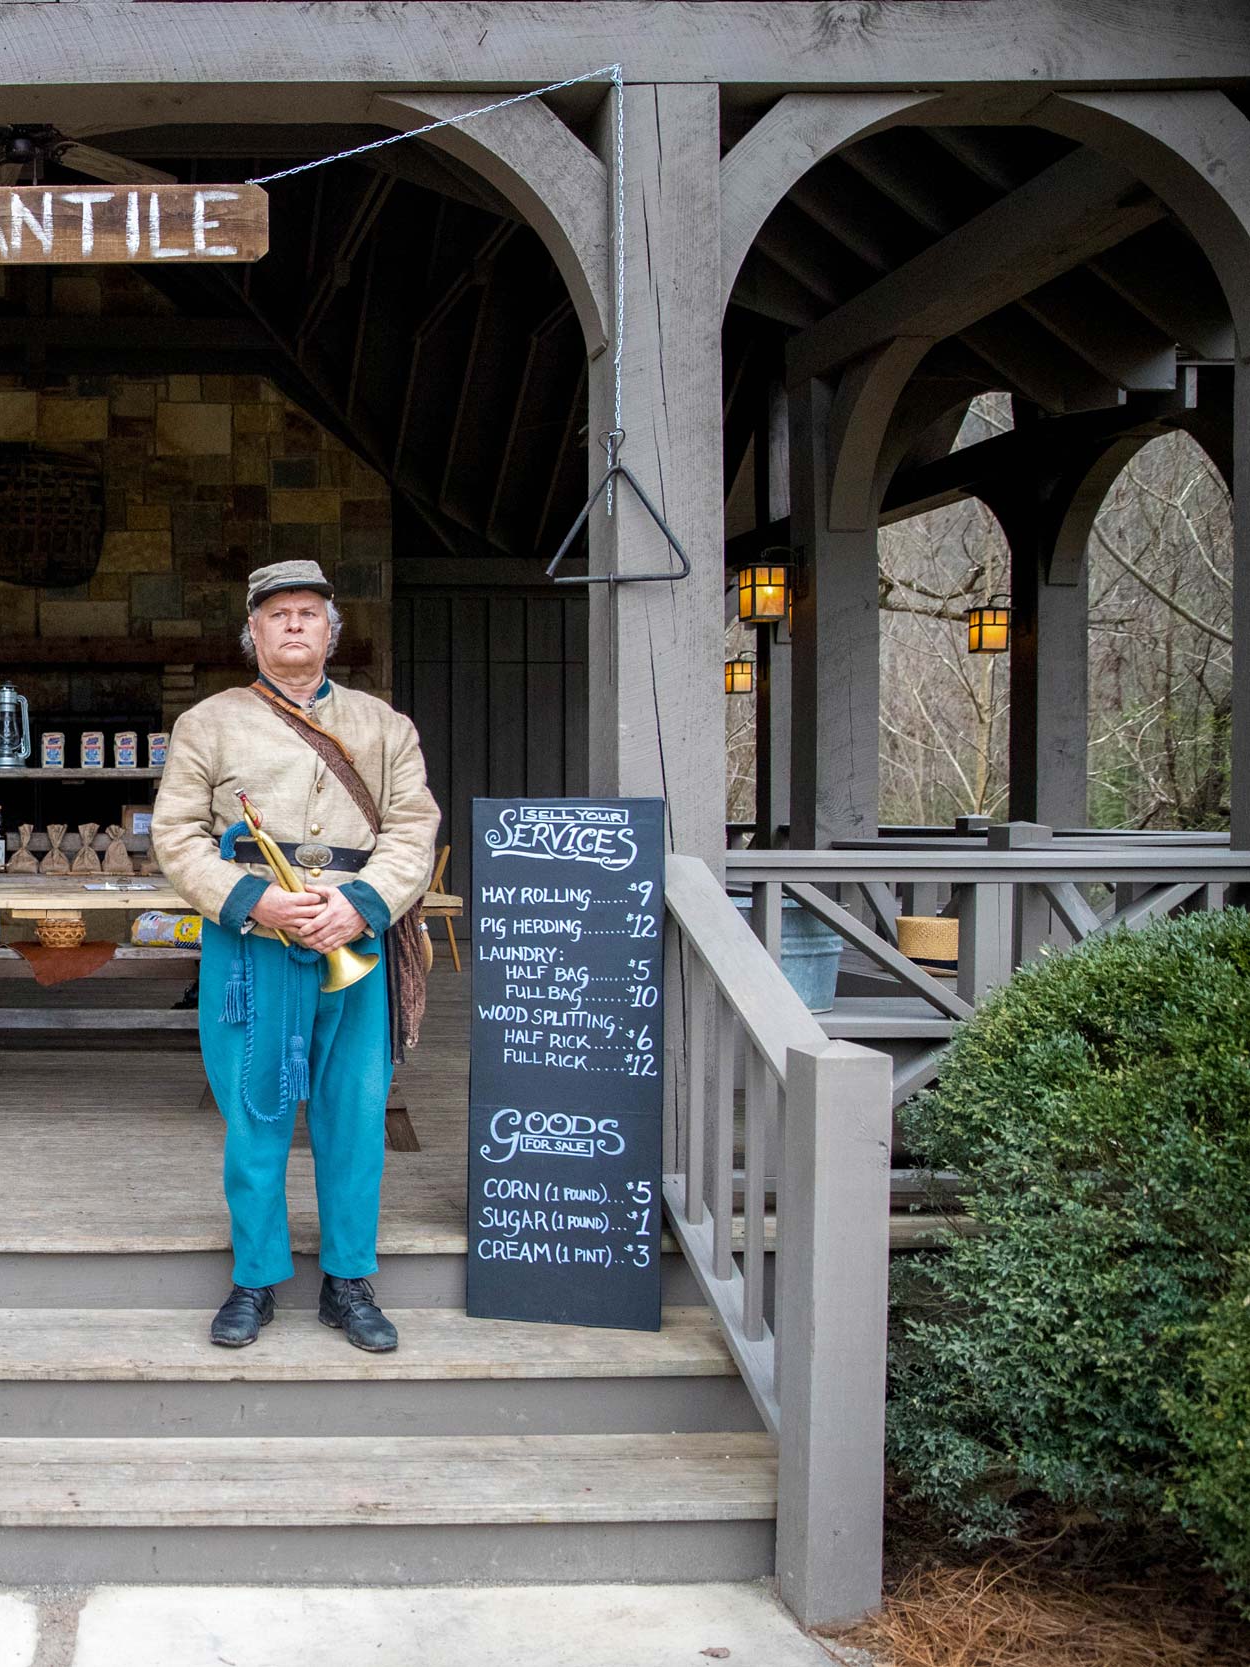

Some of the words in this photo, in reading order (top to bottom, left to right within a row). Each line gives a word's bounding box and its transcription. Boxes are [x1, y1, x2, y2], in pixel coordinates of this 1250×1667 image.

[524, 810, 574, 820] SELL
[576, 810, 624, 822] YOUR
[485, 809, 638, 871] SERVICES
[482, 887, 517, 904] HAY
[521, 887, 592, 911] ROLLING
[480, 917, 506, 939] PIG
[513, 918, 582, 942] HERDING
[506, 965, 548, 980] HALF
[554, 967, 589, 989] BAG
[506, 984, 545, 999] FULL
[548, 986, 581, 1010] BAG
[478, 1005, 528, 1023] WOOD
[505, 1029, 543, 1044] HALF
[550, 1033, 591, 1049] RICK
[504, 1049, 543, 1064] FULL
[545, 1051, 588, 1071] RICK
[480, 1109, 625, 1163] GOODS
[525, 1138, 552, 1150] FOR
[554, 1140, 590, 1152] SALE
[483, 1178, 540, 1200] CORN
[478, 1207, 549, 1238] SUGAR
[477, 1239, 552, 1264] CREAM
